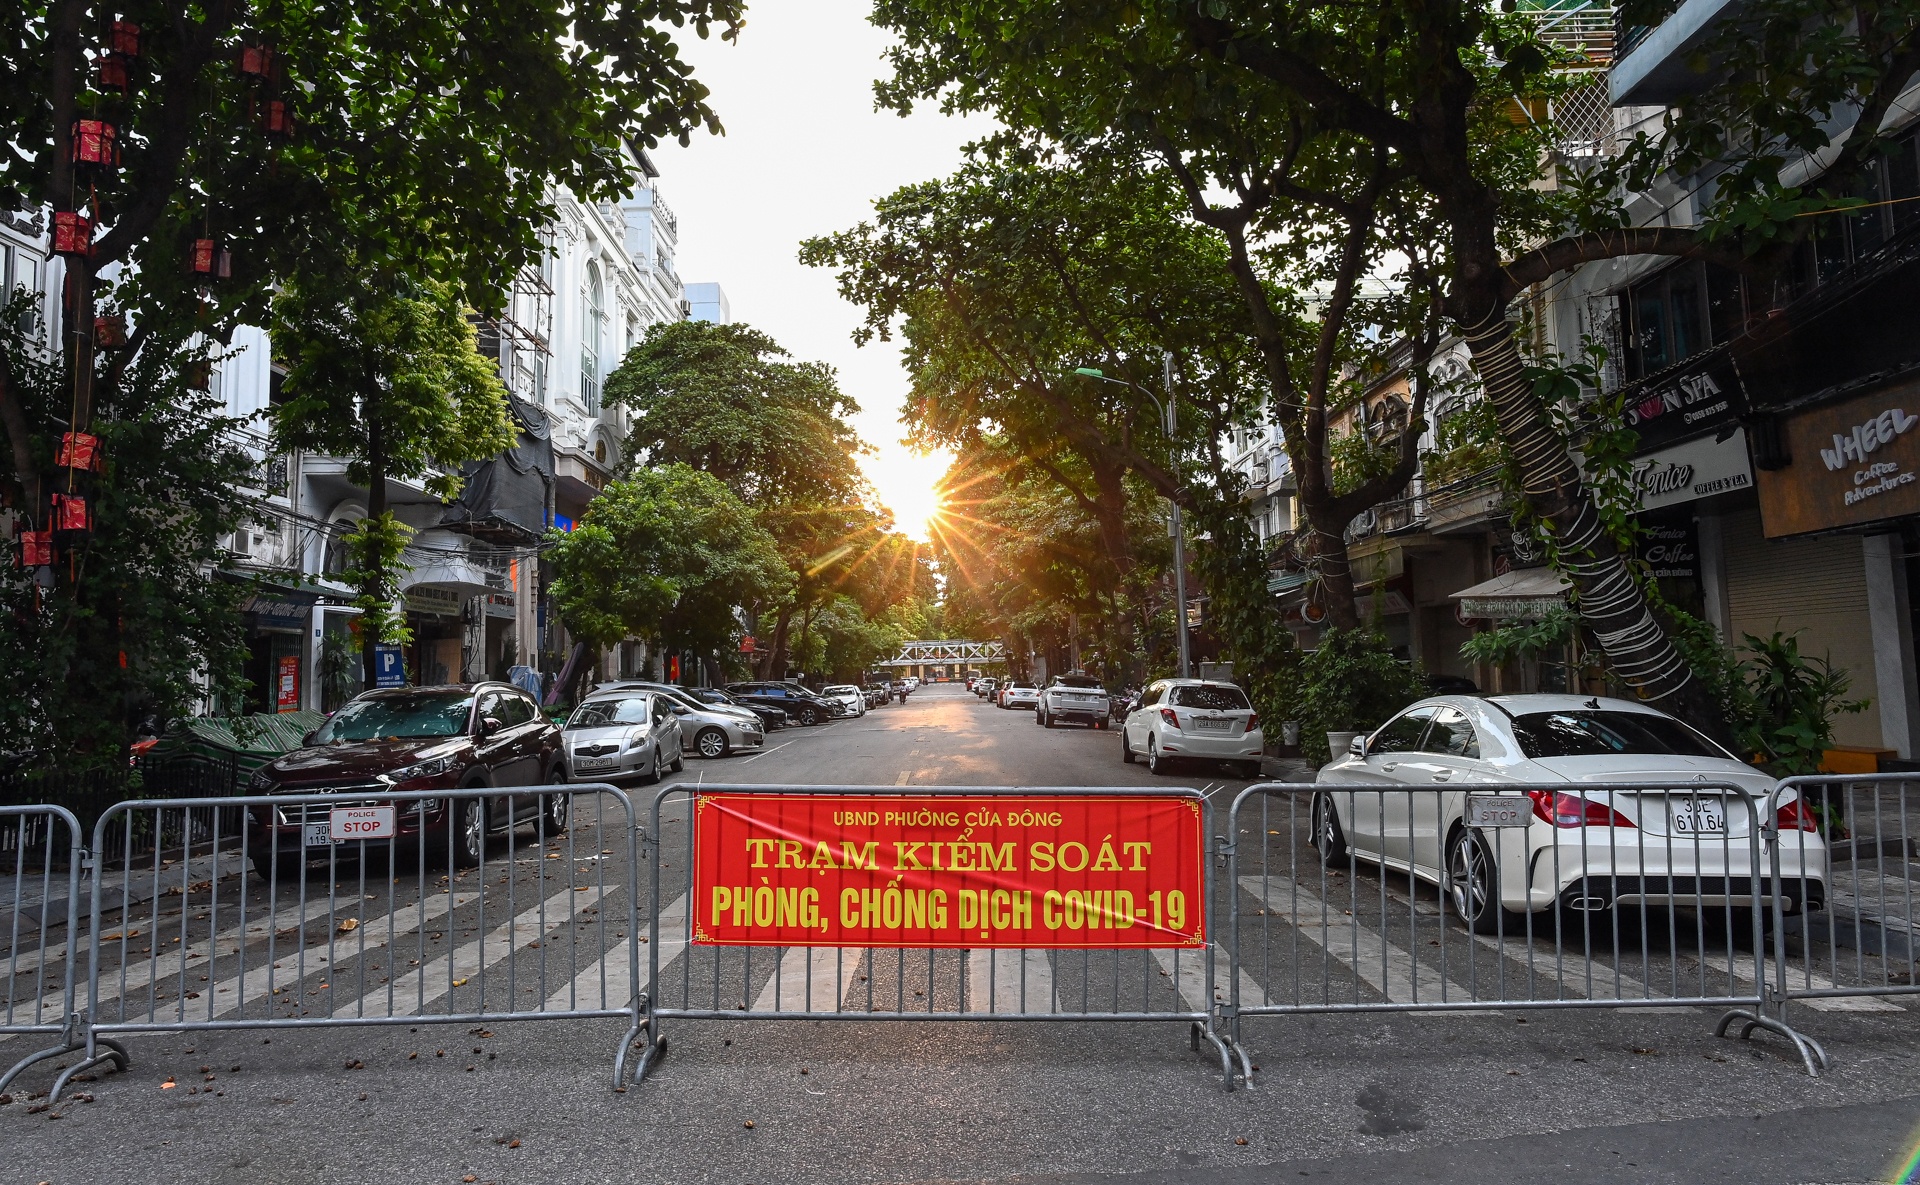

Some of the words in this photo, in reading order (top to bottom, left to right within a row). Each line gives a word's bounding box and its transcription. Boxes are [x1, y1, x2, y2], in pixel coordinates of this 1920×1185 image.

[1820, 408, 1919, 472] WHEEL
[1630, 462, 1694, 500] Fenice
[1694, 479, 1723, 494] COFFEE
[1722, 478, 1730, 491] &
[1730, 474, 1748, 489] TEA
[1853, 461, 1899, 486] Coffee
[1844, 471, 1917, 505] Adventures
[1645, 525, 1687, 540] Fenice
[1645, 543, 1695, 564] Coffee
[383, 653, 395, 672] P
[1487, 799, 1513, 807] POLICE
[834, 811, 879, 826] UBND
[886, 807, 959, 826] PHƯỜNG
[965, 806, 1003, 827] CỬA
[1007, 808, 1062, 826] ĐÔNG
[1481, 810, 1517, 821] STOP
[343, 821, 381, 833] STOP
[746, 836, 881, 876] TRẠM
[893, 828, 1018, 872] KIỂM
[1031, 833, 1152, 873] SOÁT
[711, 870, 829, 934] PHÒNG,
[840, 875, 948, 930] CHỐNG
[959, 889, 1032, 939] DỊCH
[1044, 890, 1186, 931] COVID-19
